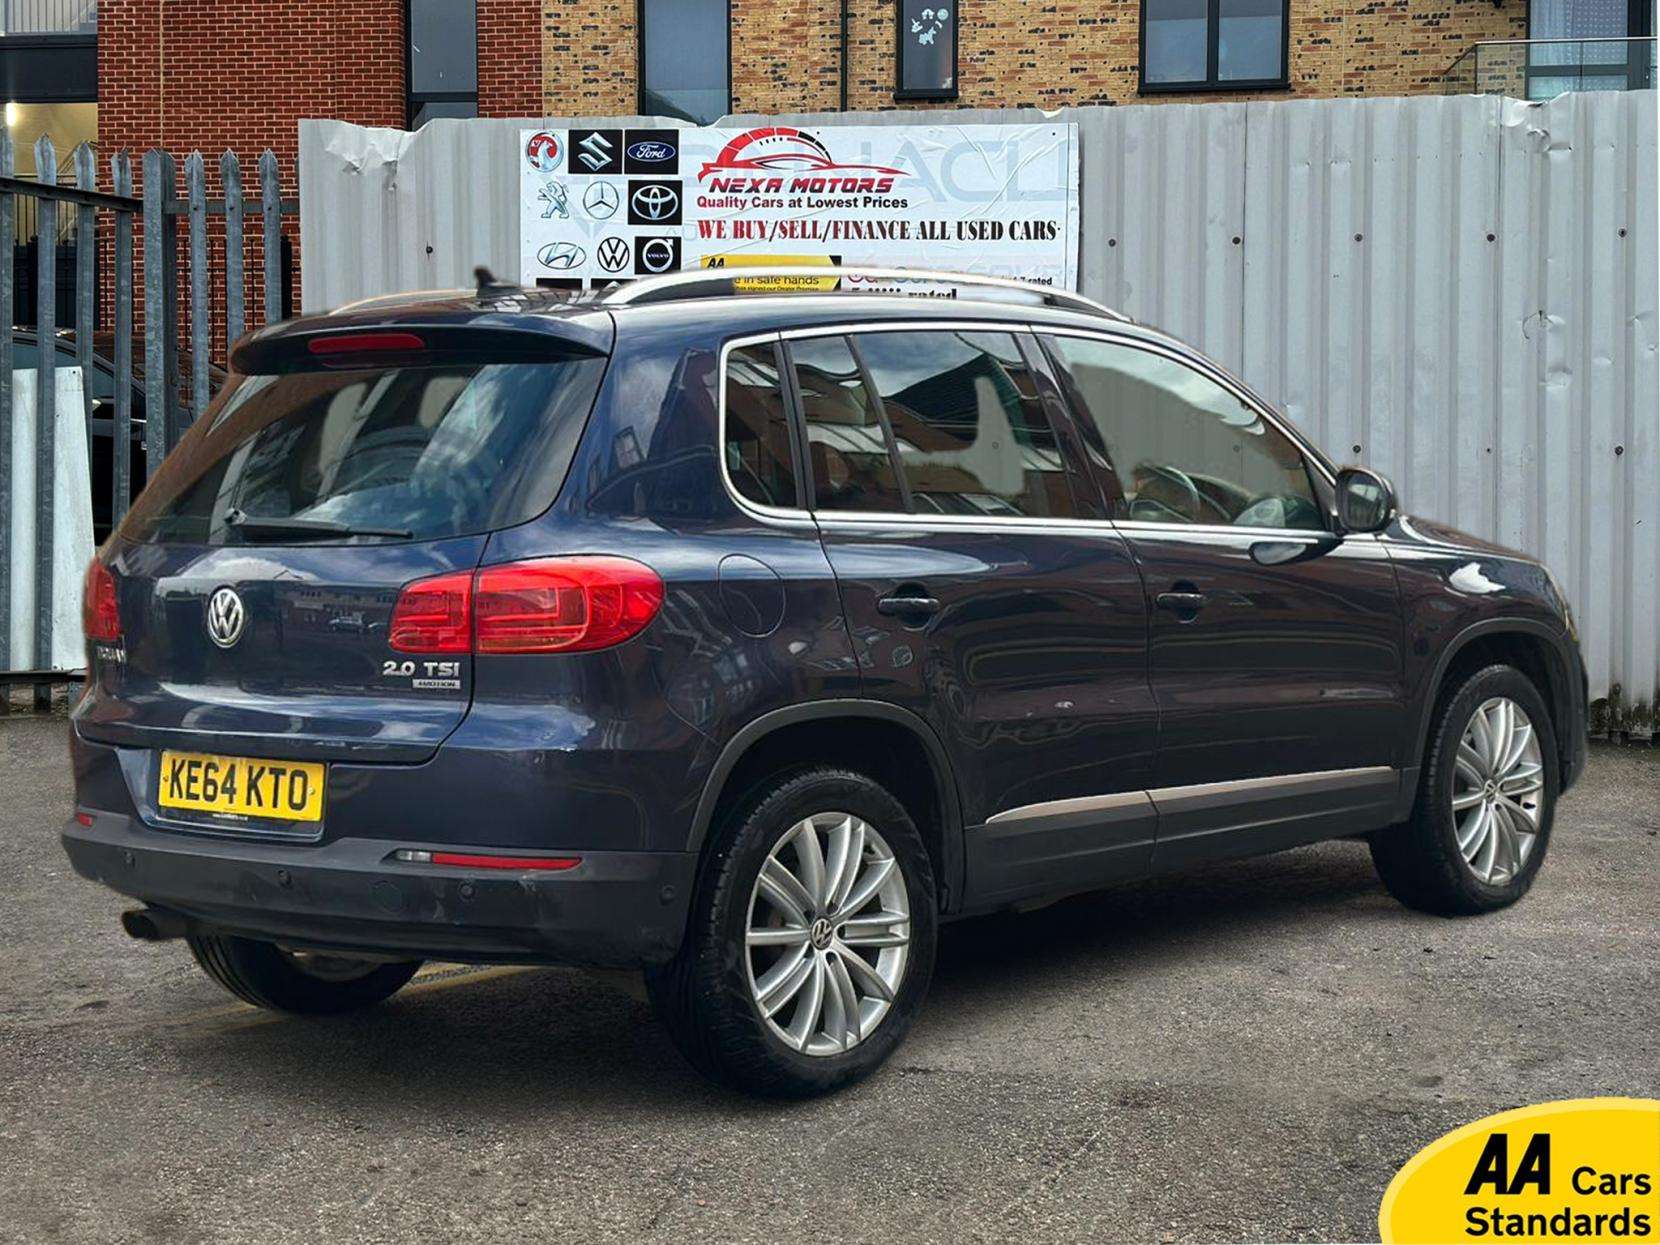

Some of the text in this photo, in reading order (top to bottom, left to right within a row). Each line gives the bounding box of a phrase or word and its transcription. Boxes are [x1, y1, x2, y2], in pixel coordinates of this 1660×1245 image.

[636, 143, 666, 159] Ford
[709, 177, 895, 194] NEXA MOTORS
[697, 195, 908, 210] Quality Cars at Lowest Prices
[697, 220, 727, 240] WE
[916, 220, 951, 240] ALL
[956, 220, 1004, 240] USED
[1008, 220, 1057, 240] CARS
[706, 257, 725, 269] AA
[423, 661, 460, 677] TSI
[169, 758, 309, 812] KE64 KTO
